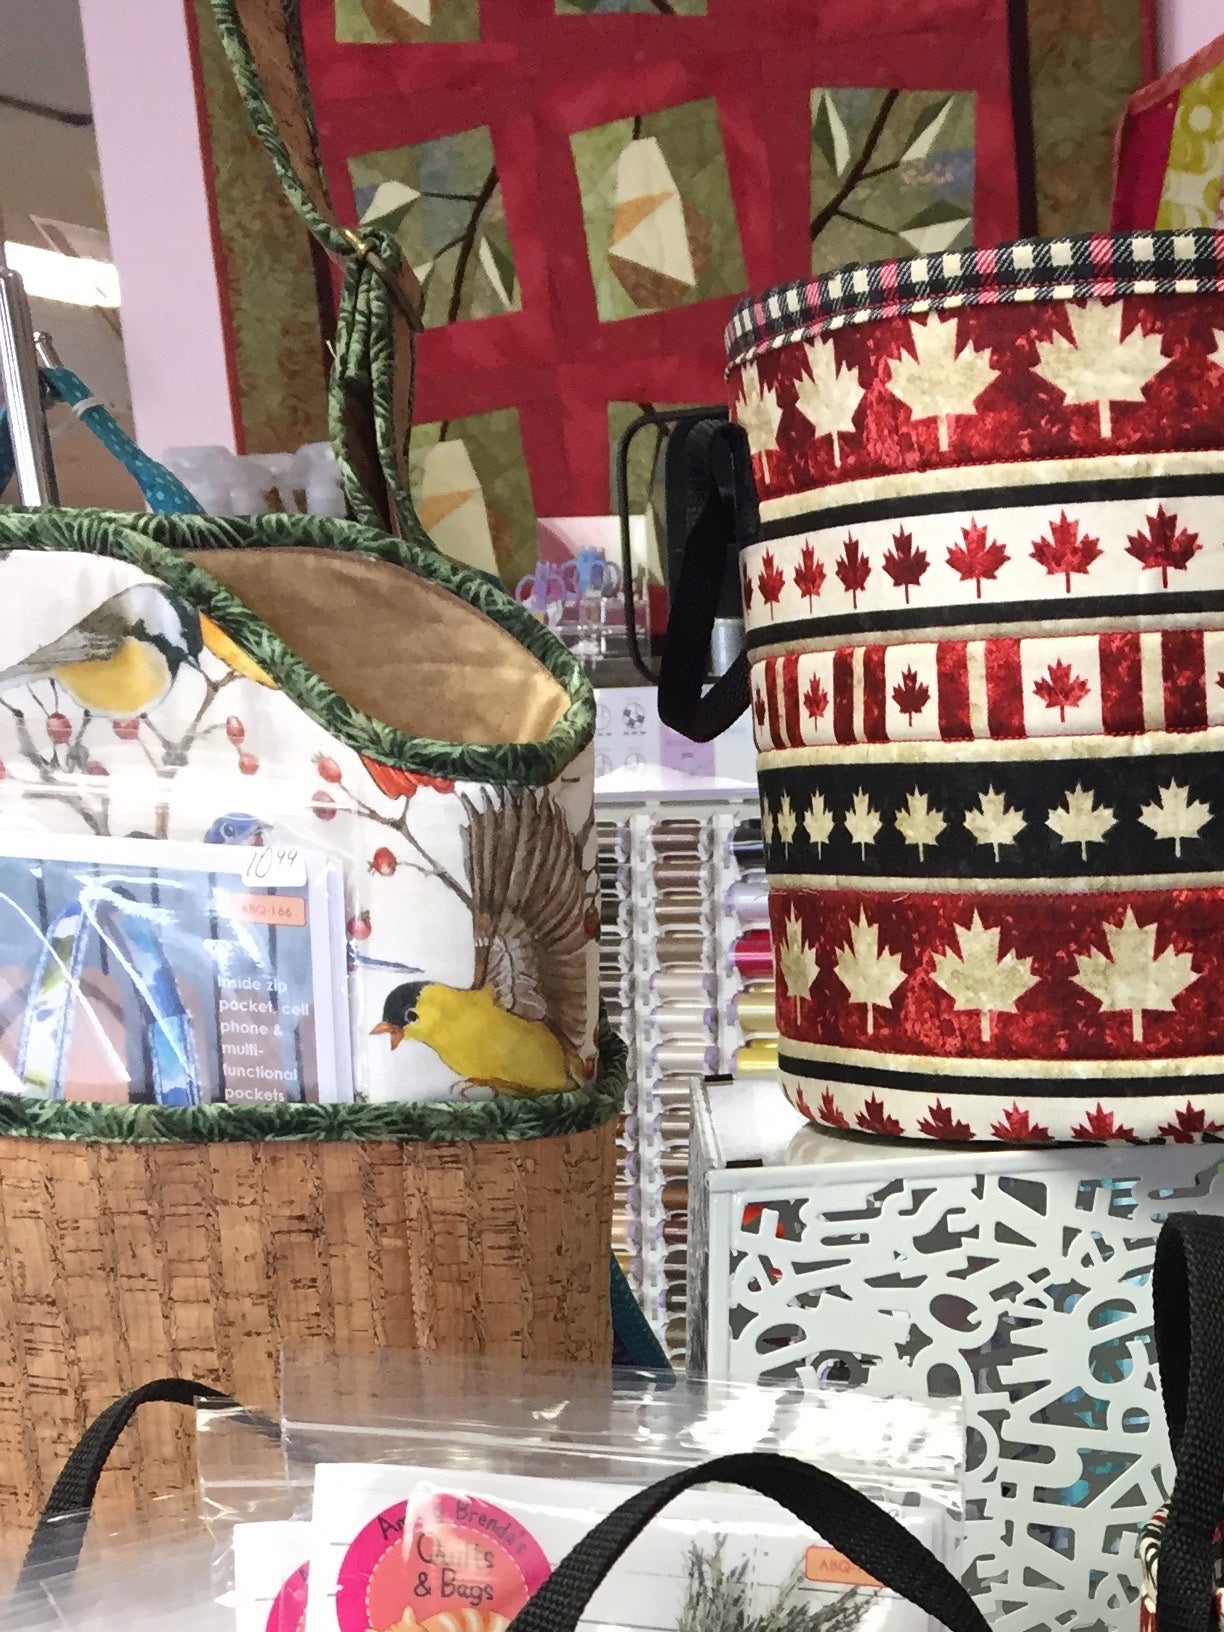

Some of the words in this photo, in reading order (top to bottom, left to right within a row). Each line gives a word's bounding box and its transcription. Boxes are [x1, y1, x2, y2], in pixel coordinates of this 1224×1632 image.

[266, 979, 288, 993] zip
[281, 1003, 309, 1016] cell
[220, 1020, 268, 1035] phone
[273, 1023, 284, 1036] &
[222, 1042, 263, 1056] multi-
[223, 1063, 298, 1081] functional
[224, 1087, 285, 1102] pockets
[414, 1571, 432, 1597] &
[440, 1567, 494, 1606] Bags
